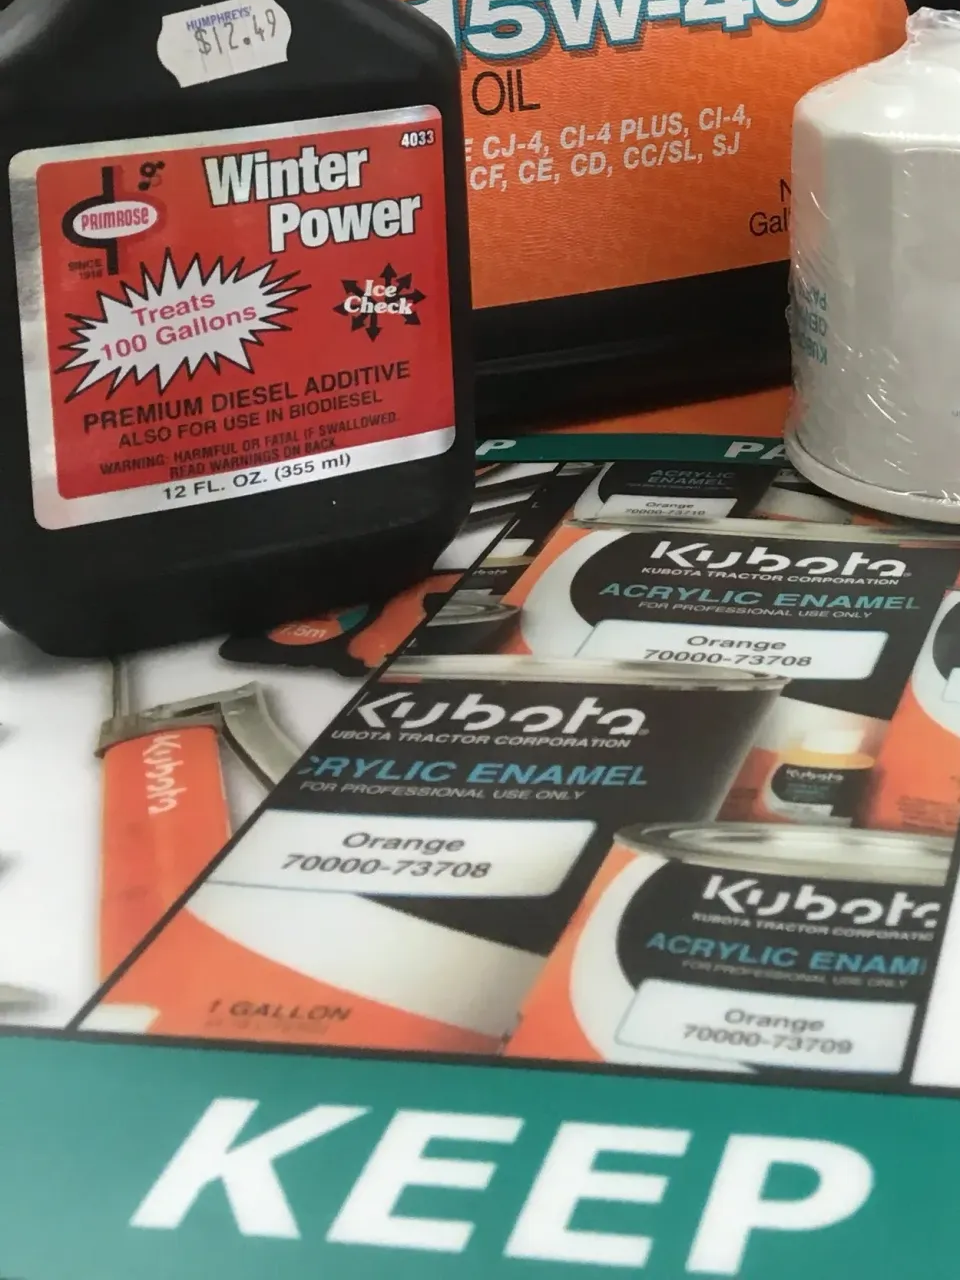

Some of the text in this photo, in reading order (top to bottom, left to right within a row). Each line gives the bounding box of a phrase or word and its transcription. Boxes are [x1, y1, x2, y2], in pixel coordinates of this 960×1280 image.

[194, 8, 277, 55] $12.49
[471, 69, 541, 116] OIL
[401, 130, 435, 148] 4033
[483, 130, 549, 160] CJ-4,
[560, 122, 612, 150] CI-4
[620, 112, 689, 143] PLUS,
[699, 104, 752, 131] CI-4,
[205, 146, 369, 207] Winter
[469, 132, 740, 192] CF, CE, CD, CC/SL, SJ
[268, 193, 422, 253] Power
[344, 293, 414, 316] Check
[365, 279, 397, 298] Ice
[132, 292, 216, 328] Treats
[101, 305, 258, 361] 100 Gallons
[83, 360, 411, 433] PREMIUM DIESEL ADDITIVE
[118, 390, 383, 449] ALSO FOR USE IN BIODIESEL
[173, 444, 237, 464] HARMFUL
[241, 438, 261, 453] OR
[264, 431, 299, 451] FATAL
[303, 426, 316, 440] IF
[319, 412, 396, 436] SWALLOWED
[170, 437, 337, 480] READ WARNINGS ON BACK
[163, 451, 352, 501] 12 FL. OZ. (355 ml)
[645, 501, 694, 510] Orange
[650, 540, 908, 579] Kubota
[641, 566, 900, 587] KUBOTA TRACTOR CORPORATION
[599, 582, 921, 611] ACRYLIC ENAMEL
[638, 601, 873, 620] FOR PROFESSIONAL USE ONLY
[642, 648, 812, 668] 70000-73708
[686, 635, 788, 653] Orange
[350, 692, 648, 736] Kubota
[398, 732, 631, 748] TRACTOR CORPORATION
[466, 761, 648, 787] ENAMEL
[301, 781, 585, 803] FOR PROFESSIONAL USE ONLY
[342, 831, 465, 854] Orange
[280, 854, 491, 879] 70000-73708
[692, 912, 830, 936] KUBOTA TRACTOR
[646, 932, 799, 968] ACRYLIC
[224, 1000, 351, 1022] GALLON
[724, 1007, 824, 1032] Orange
[129, 1096, 875, 1276] KEEP
